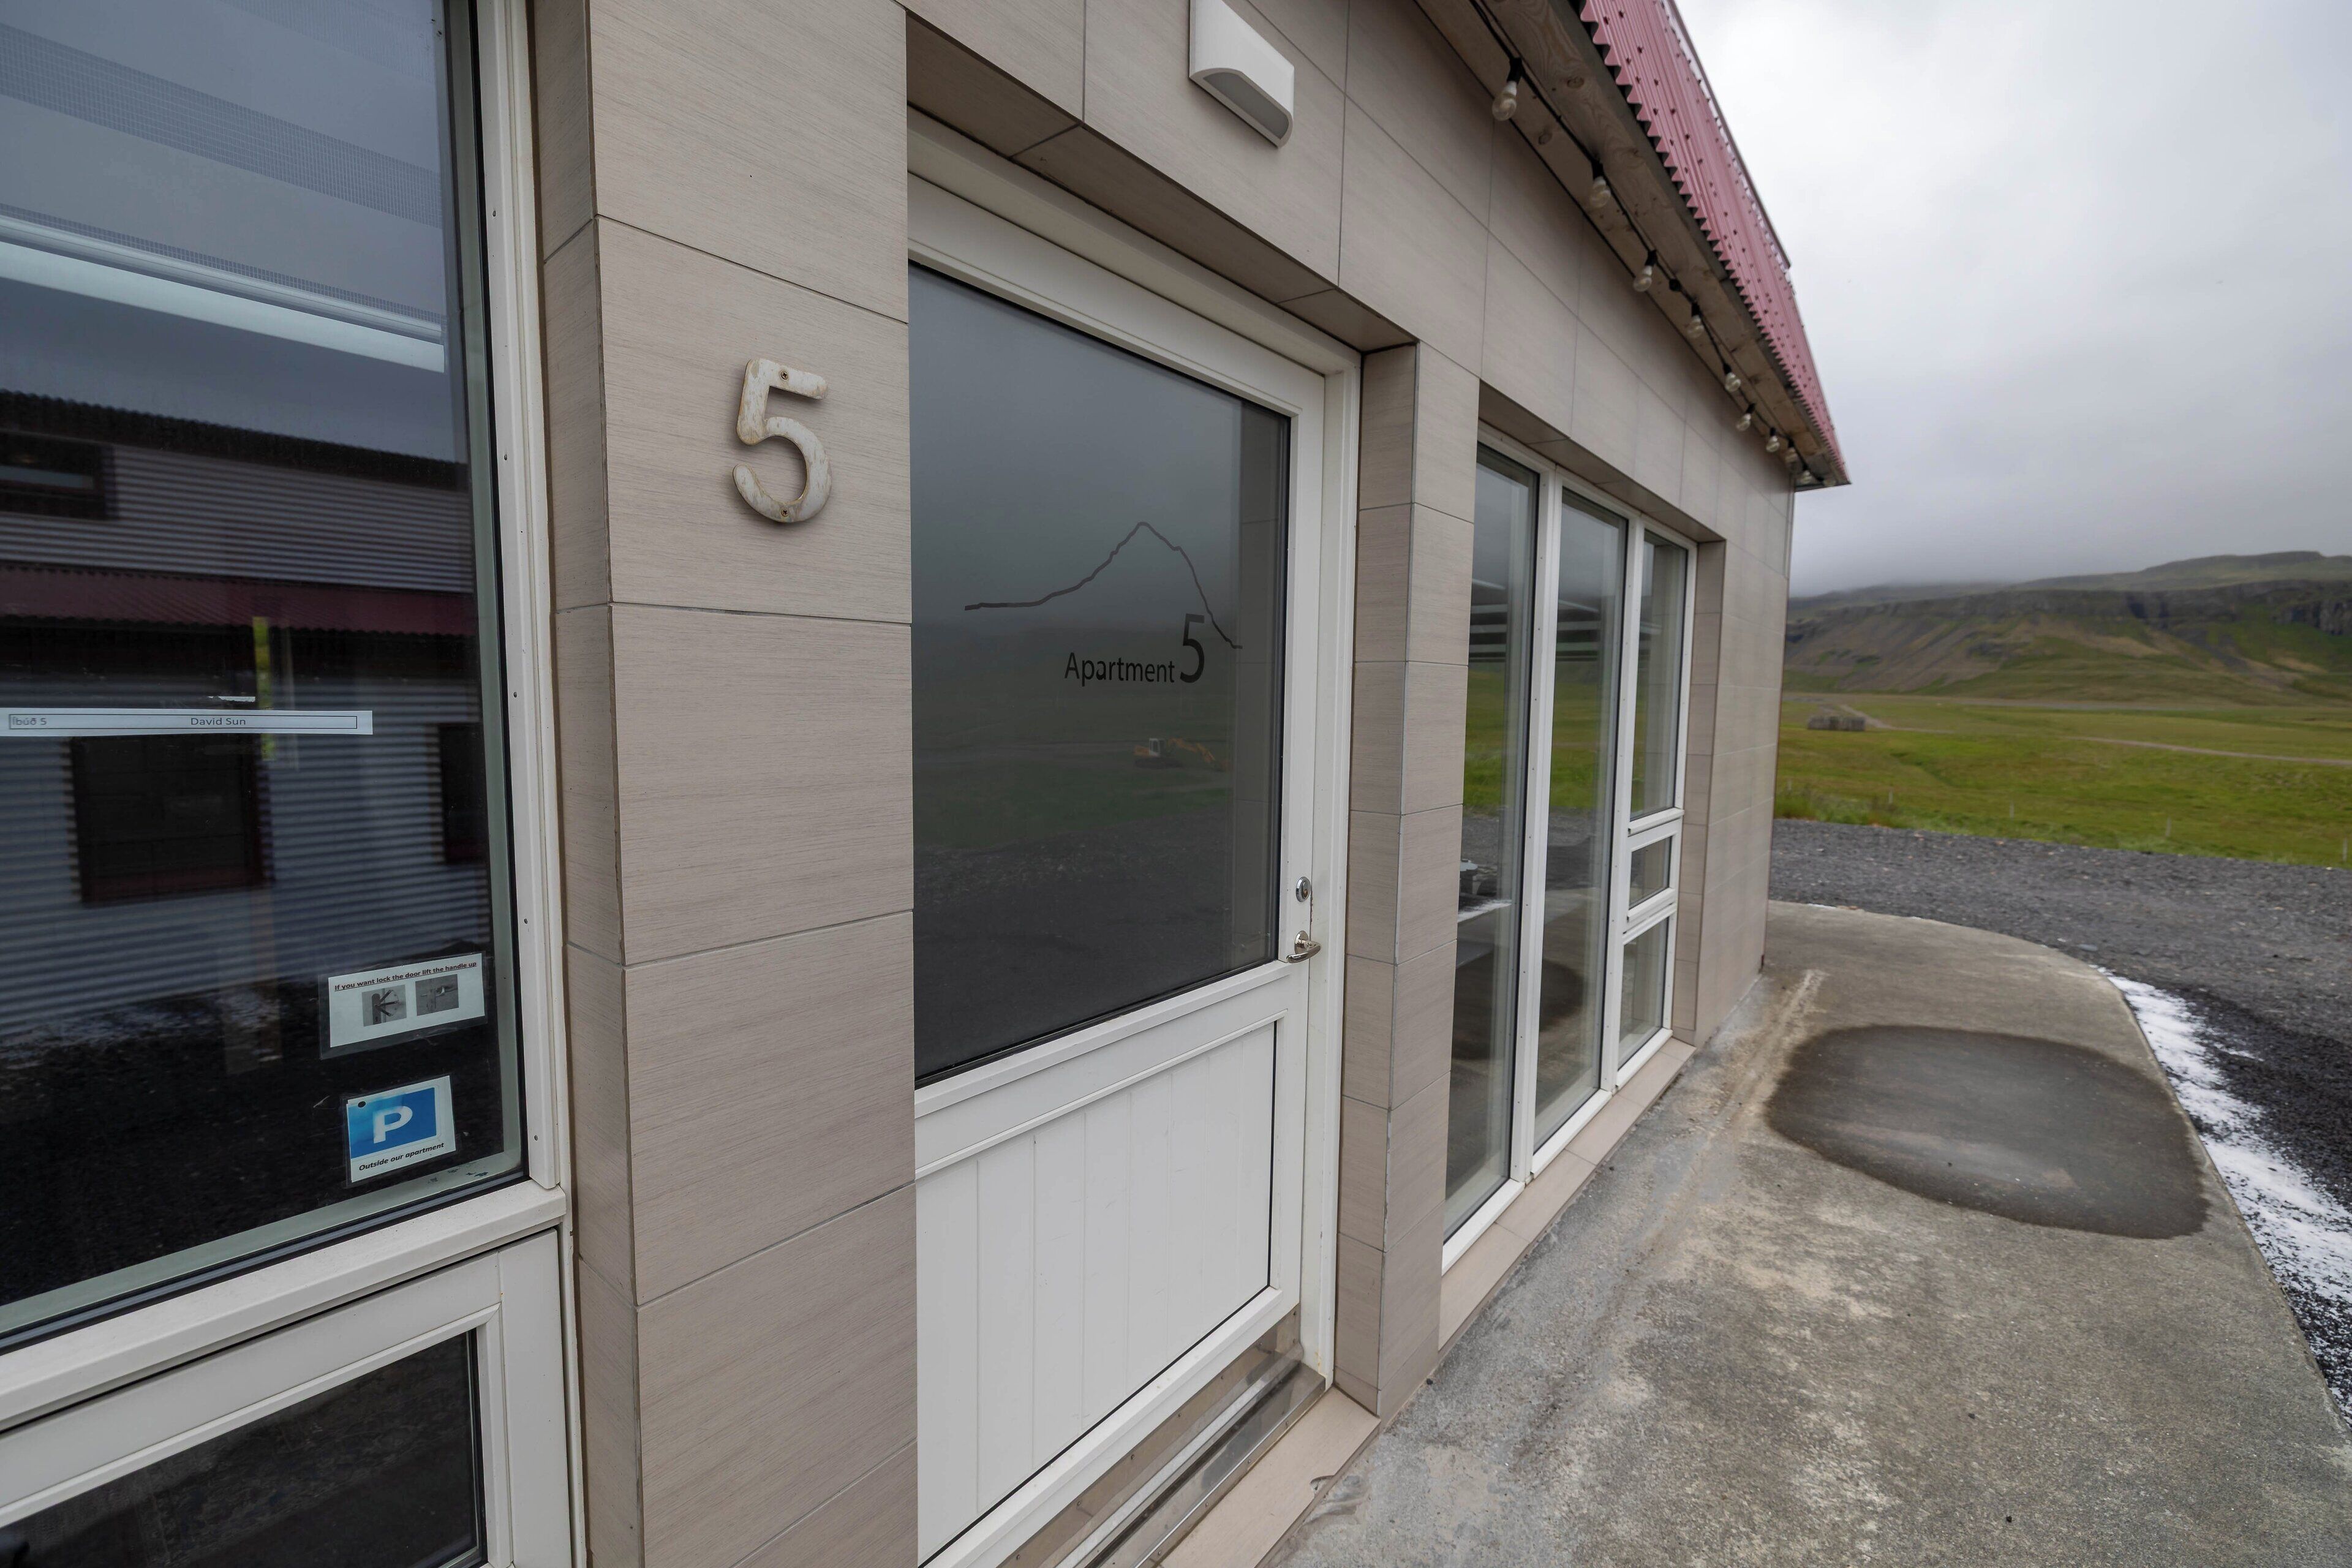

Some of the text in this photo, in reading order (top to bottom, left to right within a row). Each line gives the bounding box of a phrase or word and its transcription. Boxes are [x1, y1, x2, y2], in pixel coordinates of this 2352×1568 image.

[733, 358, 832, 523] 5
[1065, 613, 1205, 687] Apartment 5
[373, 1106, 412, 1144] P
[359, 1158, 389, 1171] Outside
[405, 1142, 445, 1158] apartment
